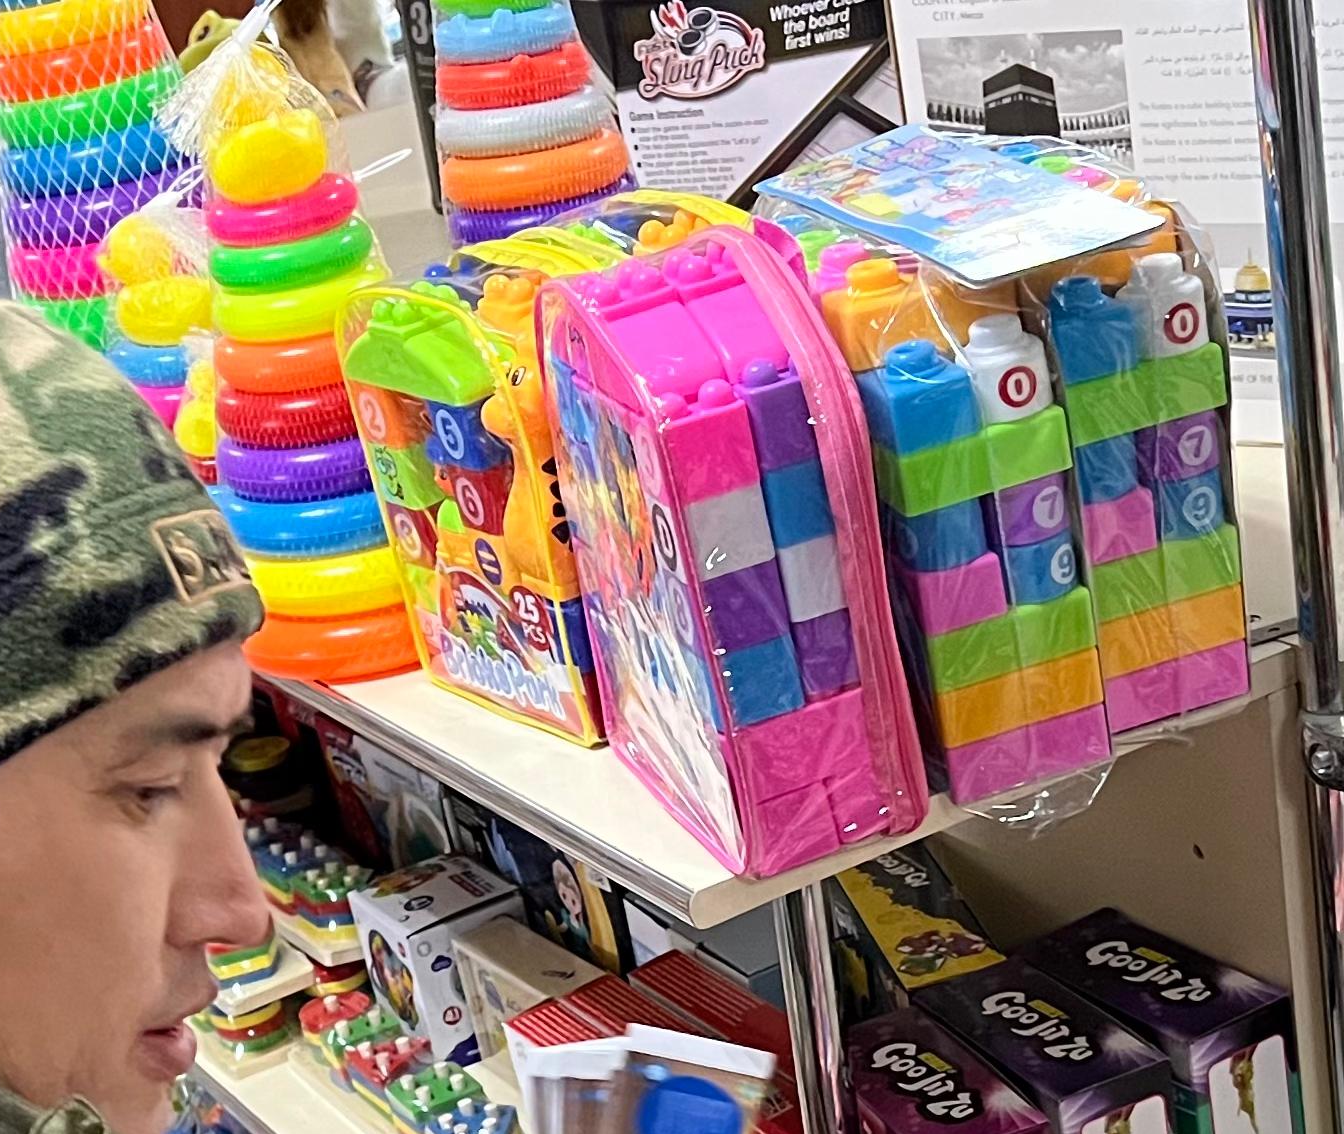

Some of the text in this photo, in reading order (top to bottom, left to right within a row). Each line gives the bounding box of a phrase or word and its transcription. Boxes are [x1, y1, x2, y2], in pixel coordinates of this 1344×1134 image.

[783, 8, 850, 35] the board
[785, 25, 851, 50] first wins!
[709, 43, 763, 82] Puck
[513, 591, 540, 624] 25
